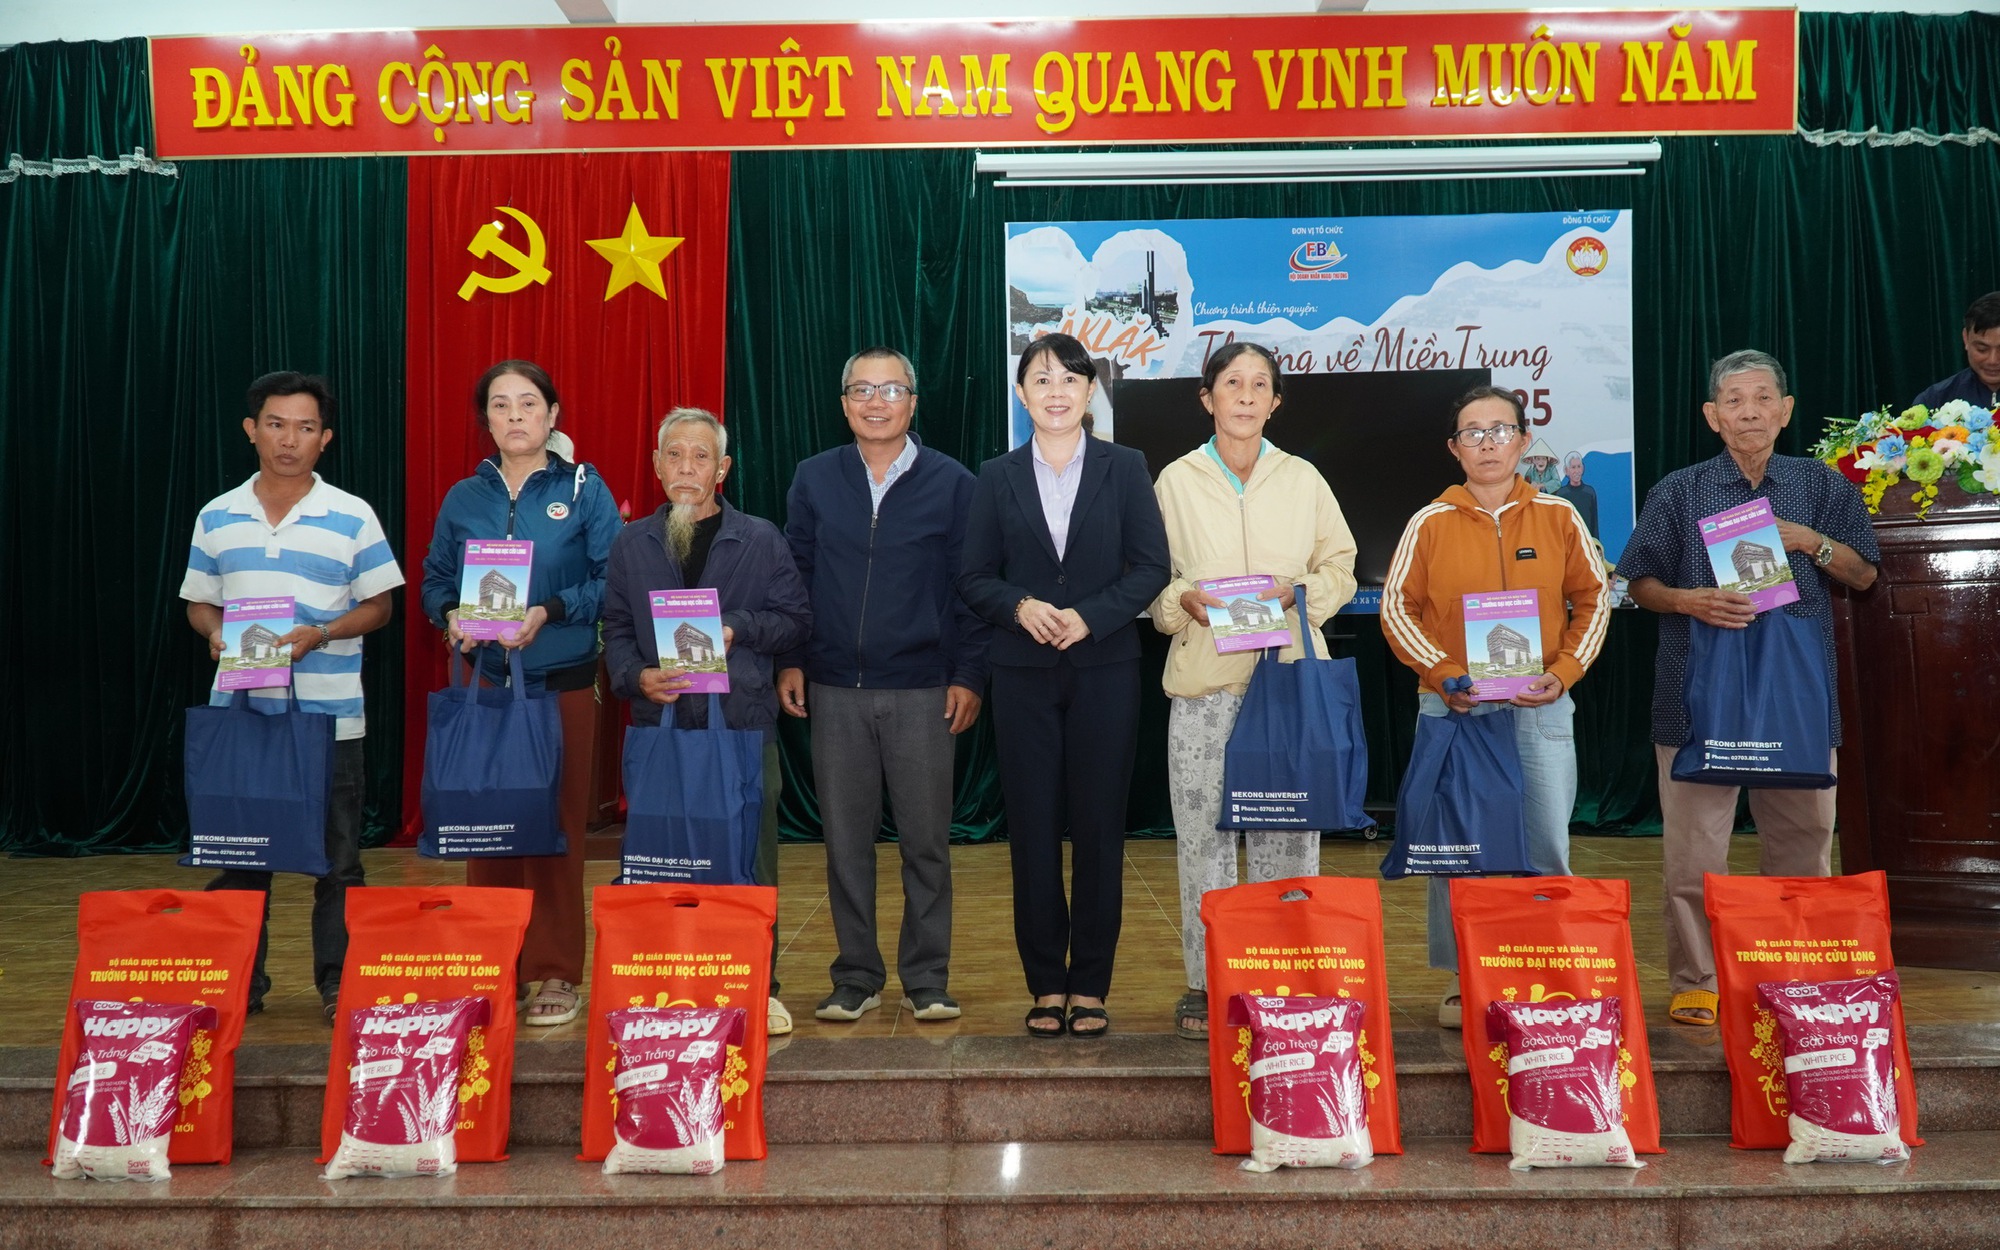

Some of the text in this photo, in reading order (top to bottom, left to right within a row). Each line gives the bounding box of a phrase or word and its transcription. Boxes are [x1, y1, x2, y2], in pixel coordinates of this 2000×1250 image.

[191, 25, 1758, 143] ĐẢNG CỘNG SẢN VIỆT NAM QUANG VINH MUÔN NĂM
[1563, 216, 1581, 224] ĐỒNG
[1593, 215, 1611, 223] CHỨC
[1292, 227, 1307, 235] ĐƠN
[1308, 228, 1315, 236] VỊ
[1325, 225, 1343, 234] CHỨC
[1306, 241, 1341, 257] FBA
[1231, 303, 1254, 315] trình
[1257, 301, 1280, 316] thiện
[1326, 335, 1365, 372] về
[1455, 325, 1552, 381] Trung
[226, 836, 269, 844] UNIVERSITY
[1438, 844, 1480, 852] UNIVERSITY
[1499, 944, 1511, 953] BỘ
[1514, 944, 1534, 953] GIÁO
[1537, 946, 1555, 954] DỤC
[1557, 945, 1568, 953] VÀ
[1586, 946, 1597, 955] TẠO
[1756, 939, 1767, 948] BỘ
[1770, 939, 1791, 947] GIÁO
[1841, 940, 1859, 948] TẠO
[381, 953, 392, 963] BỘ
[416, 954, 430, 963] DỤC
[432, 953, 442, 961] VÀ
[465, 954, 482, 963] TẠO
[632, 953, 643, 962] BỘ
[646, 953, 662, 961] GIÁO
[665, 954, 682, 962] DỤC
[684, 953, 694, 961] VÀ
[716, 954, 732, 962] TẠO
[1246, 947, 1257, 956] BỘ
[1260, 947, 1280, 955] GIÁO
[1282, 948, 1299, 956] DỤC
[1301, 946, 1311, 954] VÀ
[1333, 947, 1346, 955] TẠO
[1737, 949, 1876, 965] TRƯỜNG ĐẠI HỌC CỬU LONG
[109, 958, 118, 967] BỘ
[120, 958, 139, 966] GIÁO
[141, 959, 158, 967] DỤC
[161, 958, 172, 966] VÀ
[195, 959, 212, 967] TẠO
[1227, 956, 1365, 972] TRƯỜNG ĐẠI HỌC CỬU LONG
[1480, 955, 1616, 971] TRƯỜNG ĐẠI HỌC CỬU LONG
[91, 967, 229, 985] TRƯỜNG ĐẠI HỌC CỬU LONG
[360, 963, 500, 980] TRƯỜNG ĐẠI HỌC CỬU LONG
[612, 963, 750, 980] TRƯỜNG ĐẠI HỌC CỬU LONG
[1259, 1005, 1347, 1032] Happy
[1512, 1001, 1602, 1026] Happy
[1790, 1001, 1878, 1024] Happy
[84, 1016, 177, 1039] Happy
[622, 1016, 720, 1040] Happy
[1265, 1058, 1305, 1070] WHITE RICE
[1524, 1054, 1546, 1065] WHITE
[1803, 1055, 1827, 1065] WHITE
[623, 1070, 658, 1084] WHITE RICE
[174, 1123, 194, 1134] MỚI
[1608, 1145, 1627, 1155] Save
